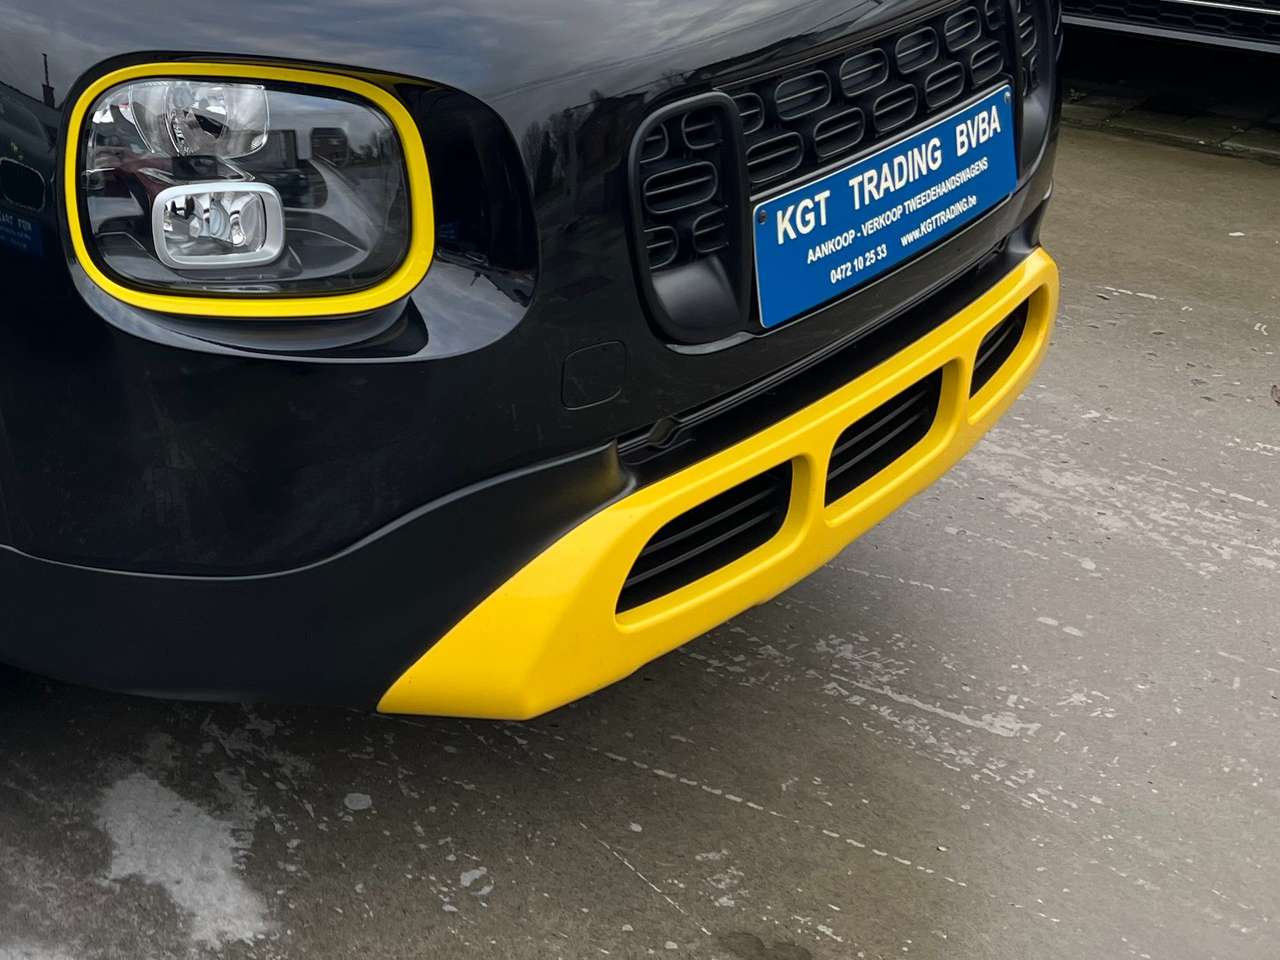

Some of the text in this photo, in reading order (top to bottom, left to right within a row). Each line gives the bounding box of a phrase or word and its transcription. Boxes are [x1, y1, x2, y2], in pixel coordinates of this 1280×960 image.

[776, 105, 1001, 244] KGT TRADING BVBA
[807, 229, 855, 264] AANKOOP
[861, 205, 904, 237] VERKOOP
[903, 156, 989, 214] TWEEDEHANDSWAGENS
[830, 194, 977, 284] 0472 10 25 33 www.KGTTRADING.be
